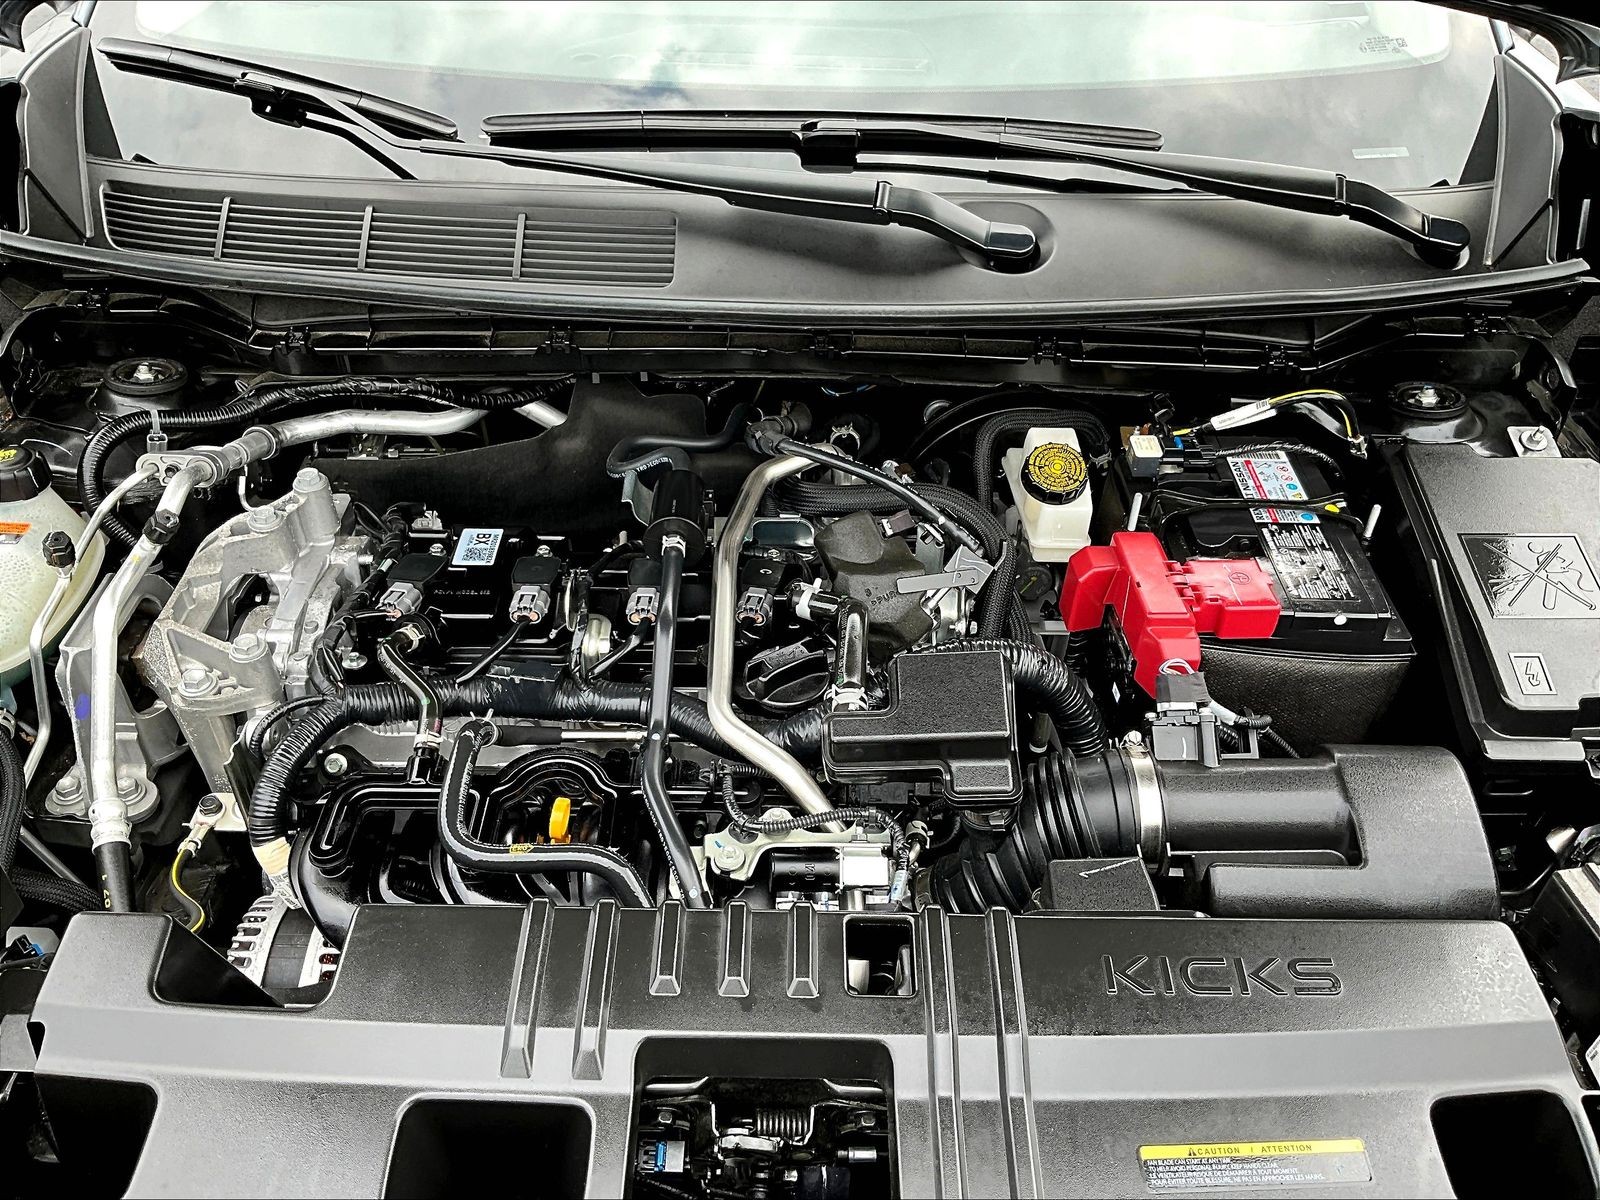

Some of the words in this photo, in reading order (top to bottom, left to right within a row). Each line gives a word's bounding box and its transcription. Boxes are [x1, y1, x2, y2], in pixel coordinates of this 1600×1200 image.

[1230, 461, 1252, 491] NISSAN
[474, 533, 492, 546] BX
[1102, 954, 1343, 996] KICKS
[1198, 1147, 1240, 1155] CAUTION
[1261, 1144, 1312, 1153] ATTENTION
